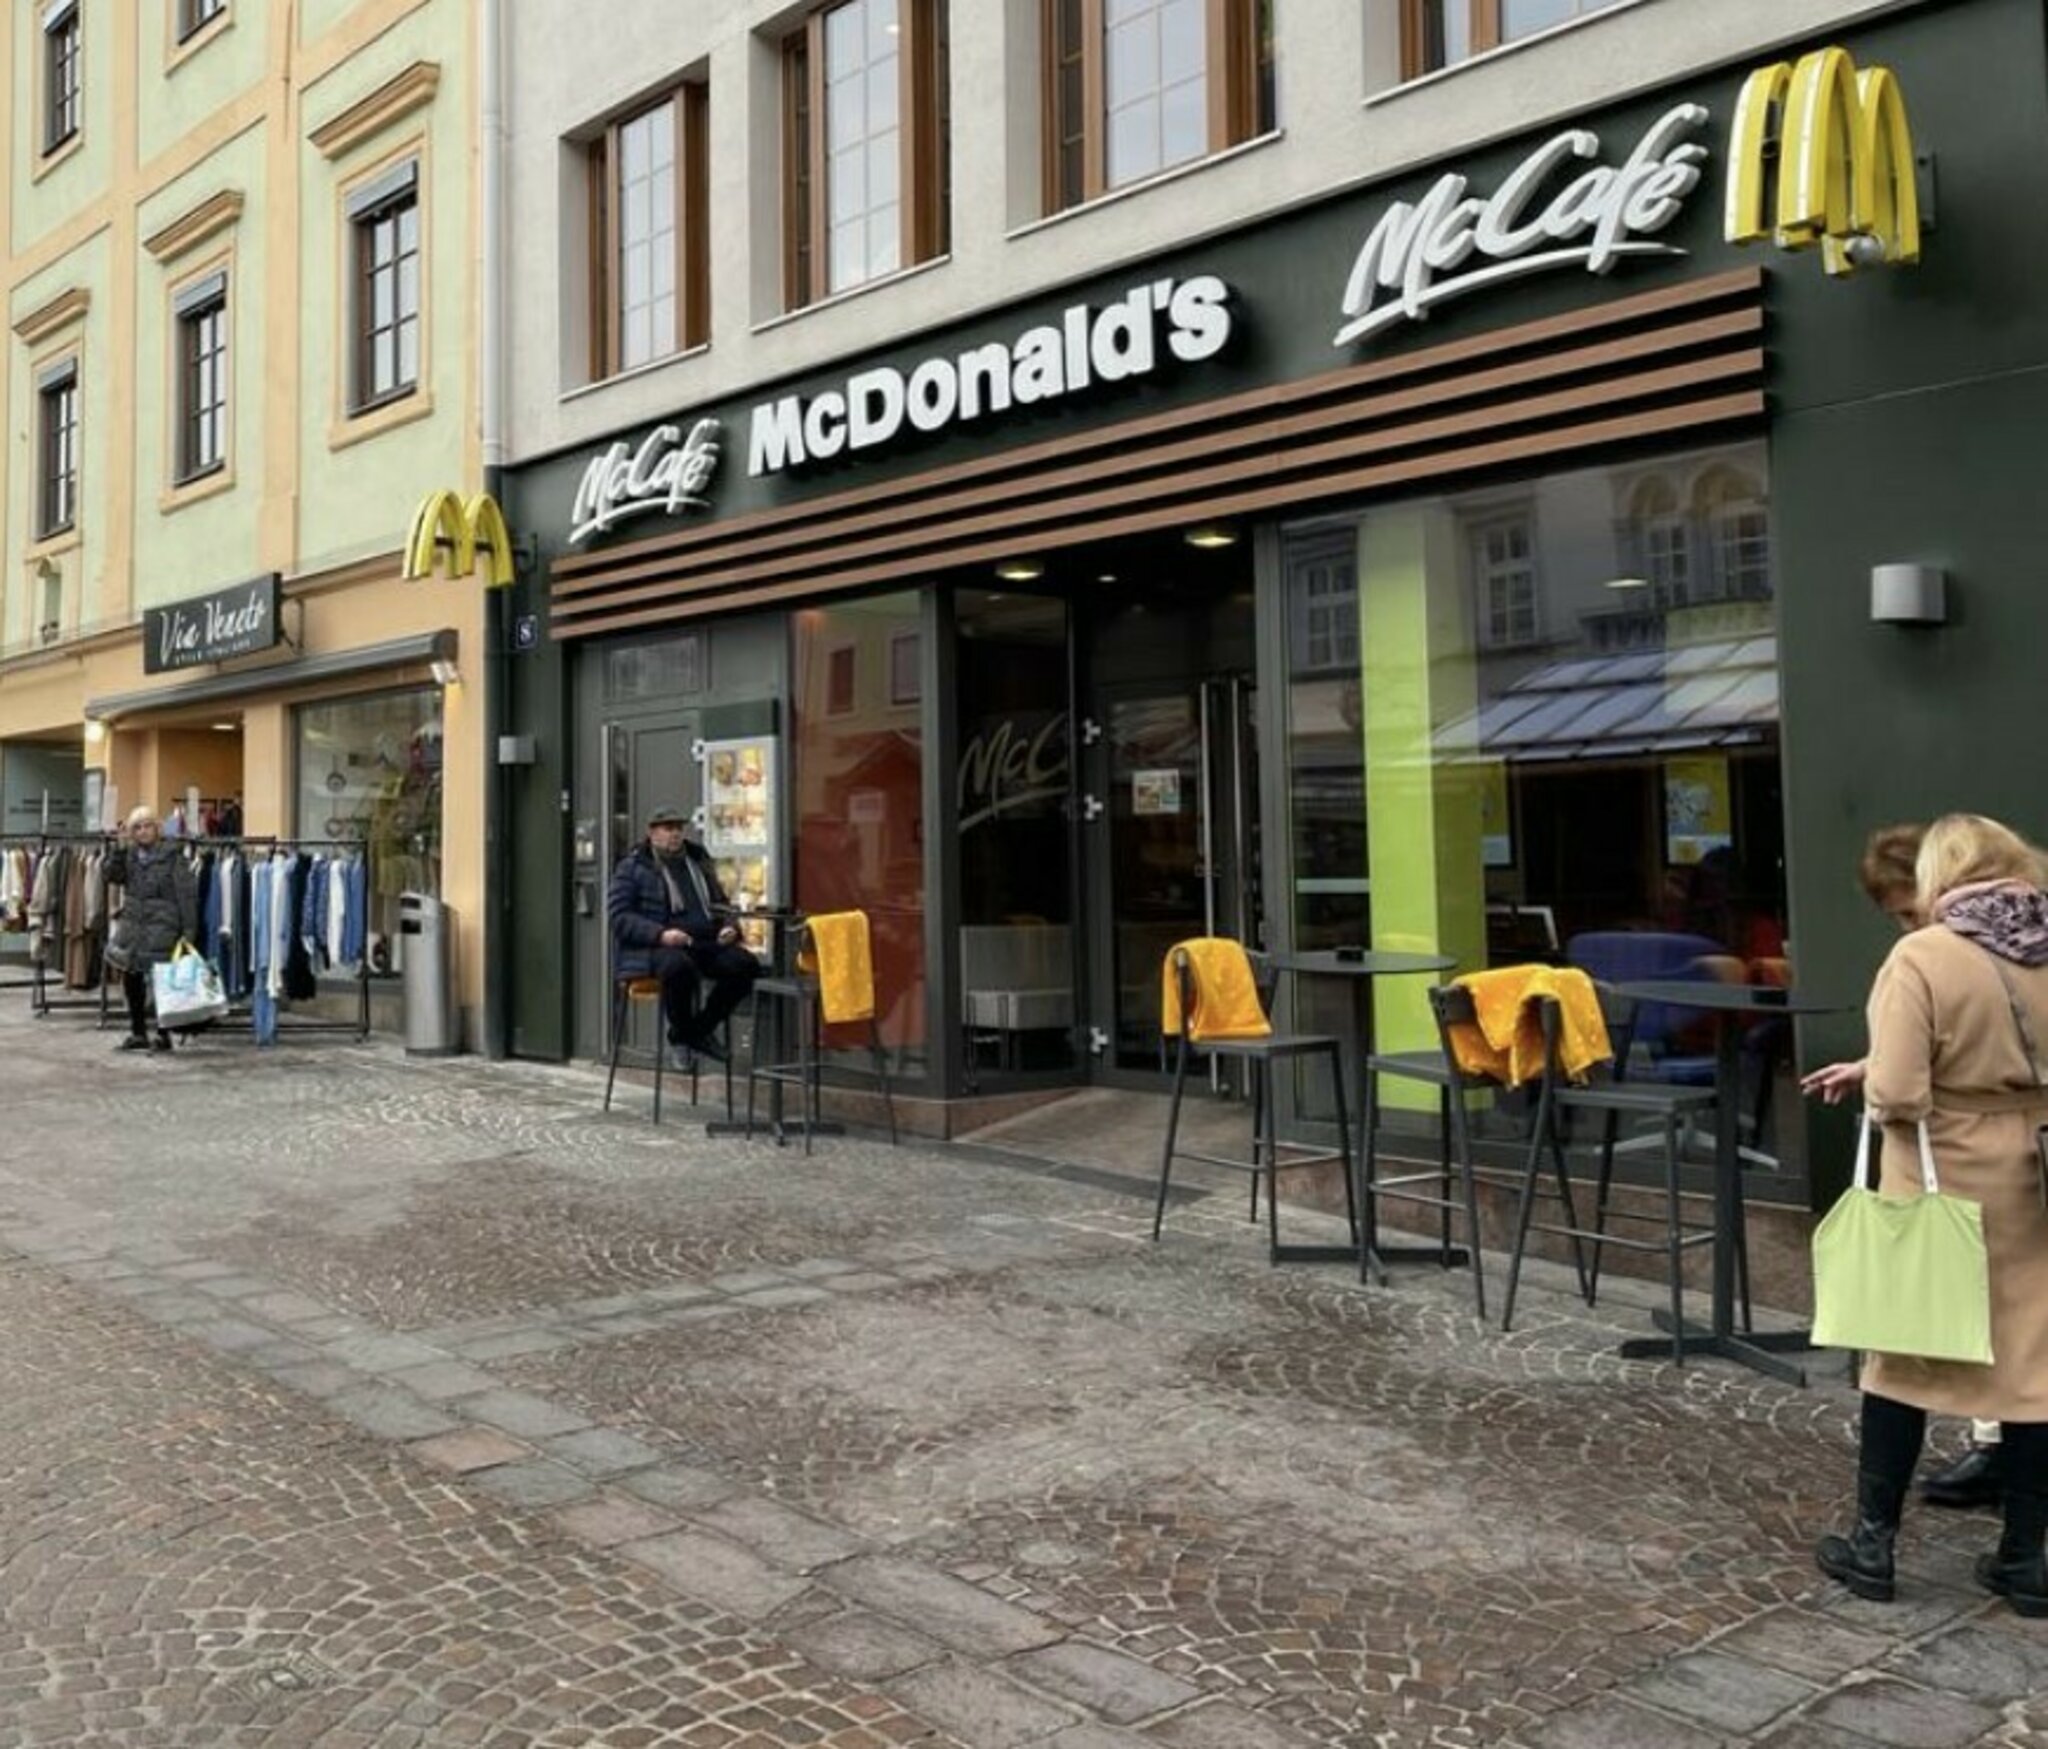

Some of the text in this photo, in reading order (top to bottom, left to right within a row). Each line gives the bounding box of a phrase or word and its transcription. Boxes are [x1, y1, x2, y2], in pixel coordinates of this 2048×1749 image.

[1336, 103, 1710, 340] McCafé
[748, 275, 1231, 477] McDonald's
[570, 418, 720, 542] McCafé
